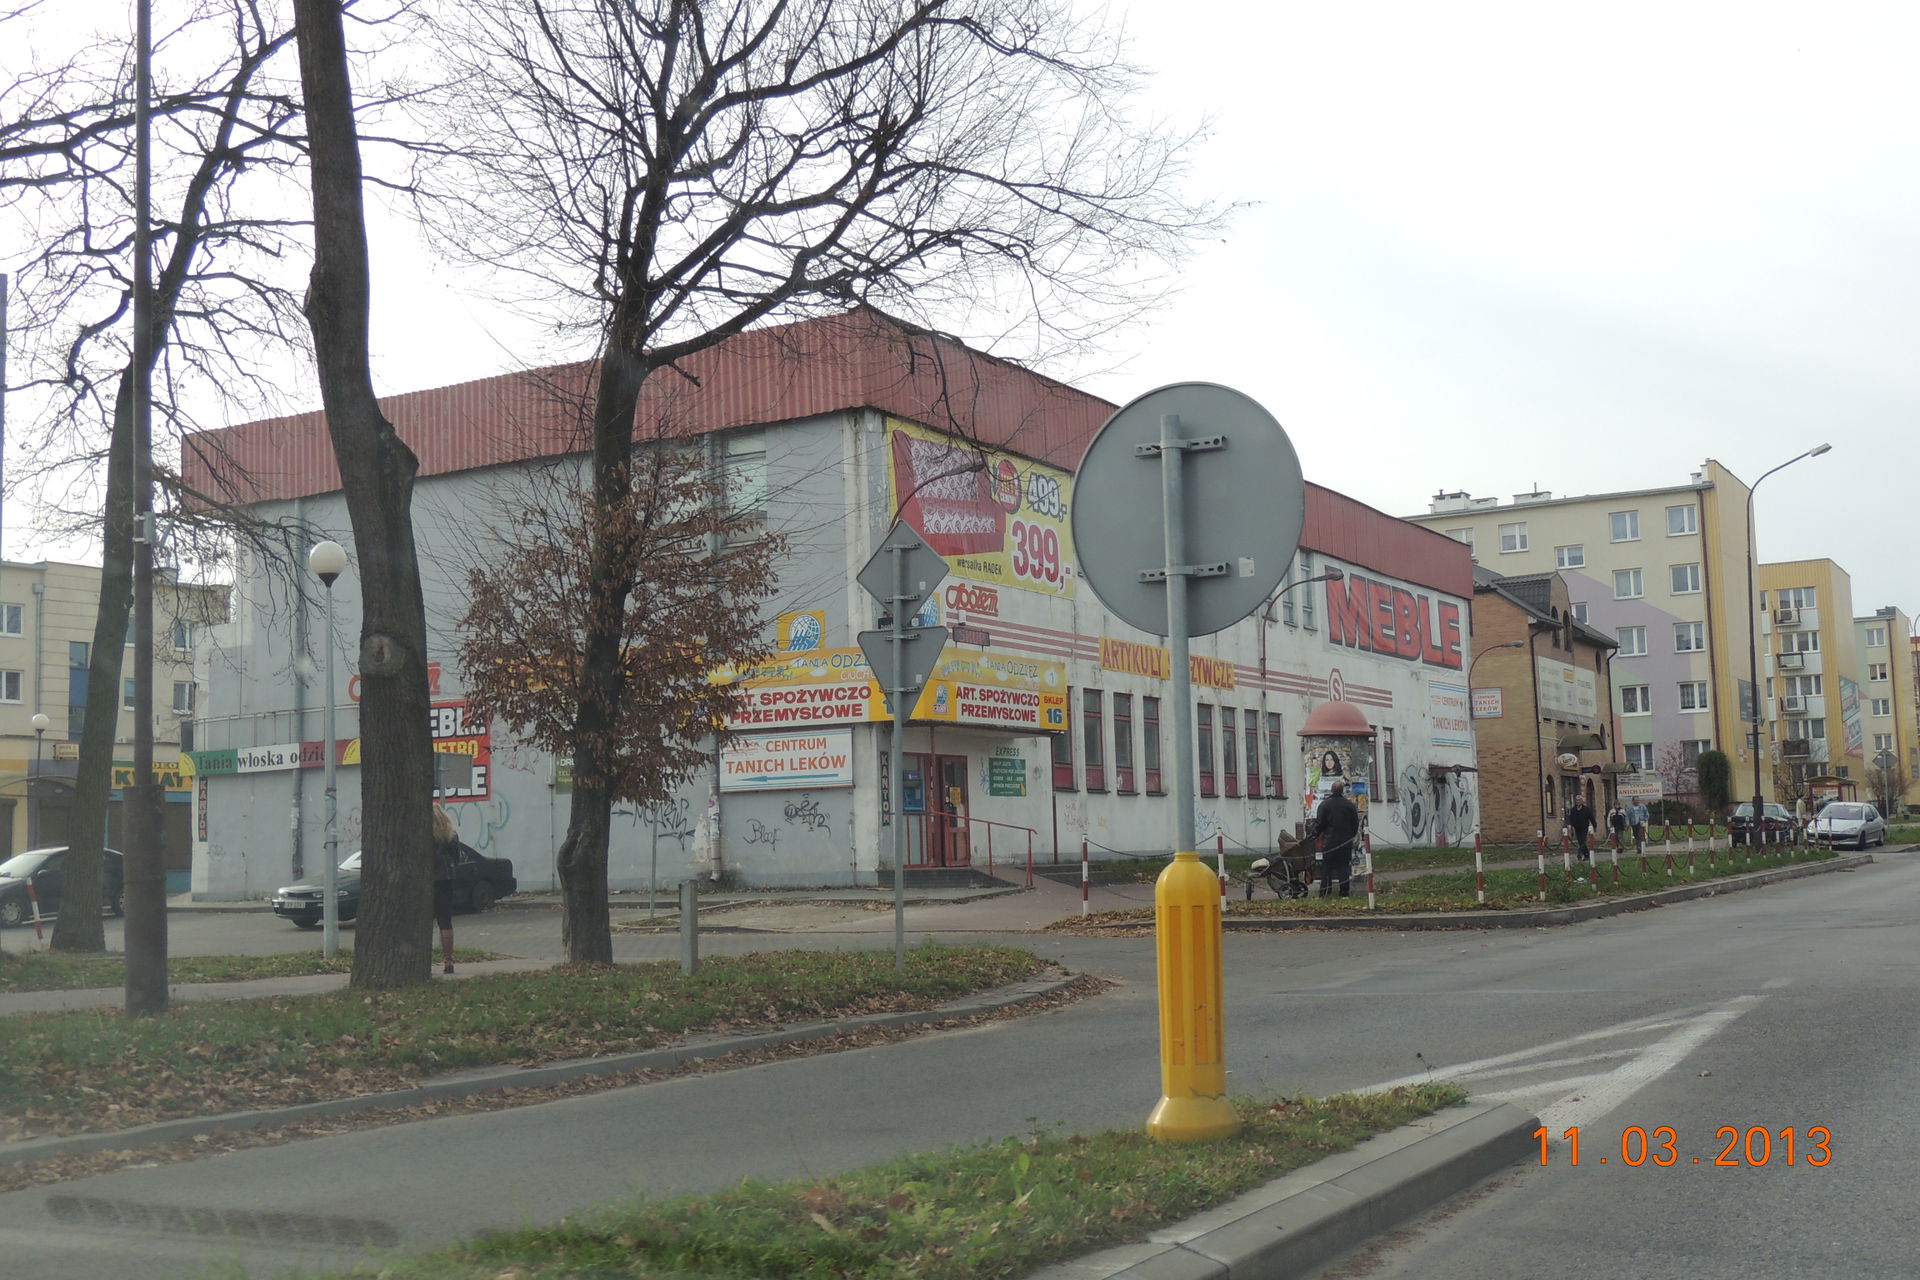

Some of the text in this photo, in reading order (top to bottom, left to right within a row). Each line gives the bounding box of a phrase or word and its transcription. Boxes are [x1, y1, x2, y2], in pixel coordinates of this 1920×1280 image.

[1324, 565, 1462, 672] MEBLE
[760, 685, 872, 706] SPOŻYWCZO
[956, 686, 1040, 707] ART. SPOŻYWCZO
[730, 703, 863, 724] PRZEMYSŁOWE
[961, 703, 1037, 722] PRZEMYSŁOWE
[1046, 708, 1063, 724] 16
[765, 737, 827, 752] CENTRUM
[238, 751, 284, 768] włoska
[726, 752, 846, 774] TANICH LEKÓW
[881, 754, 891, 824] KANTOR
